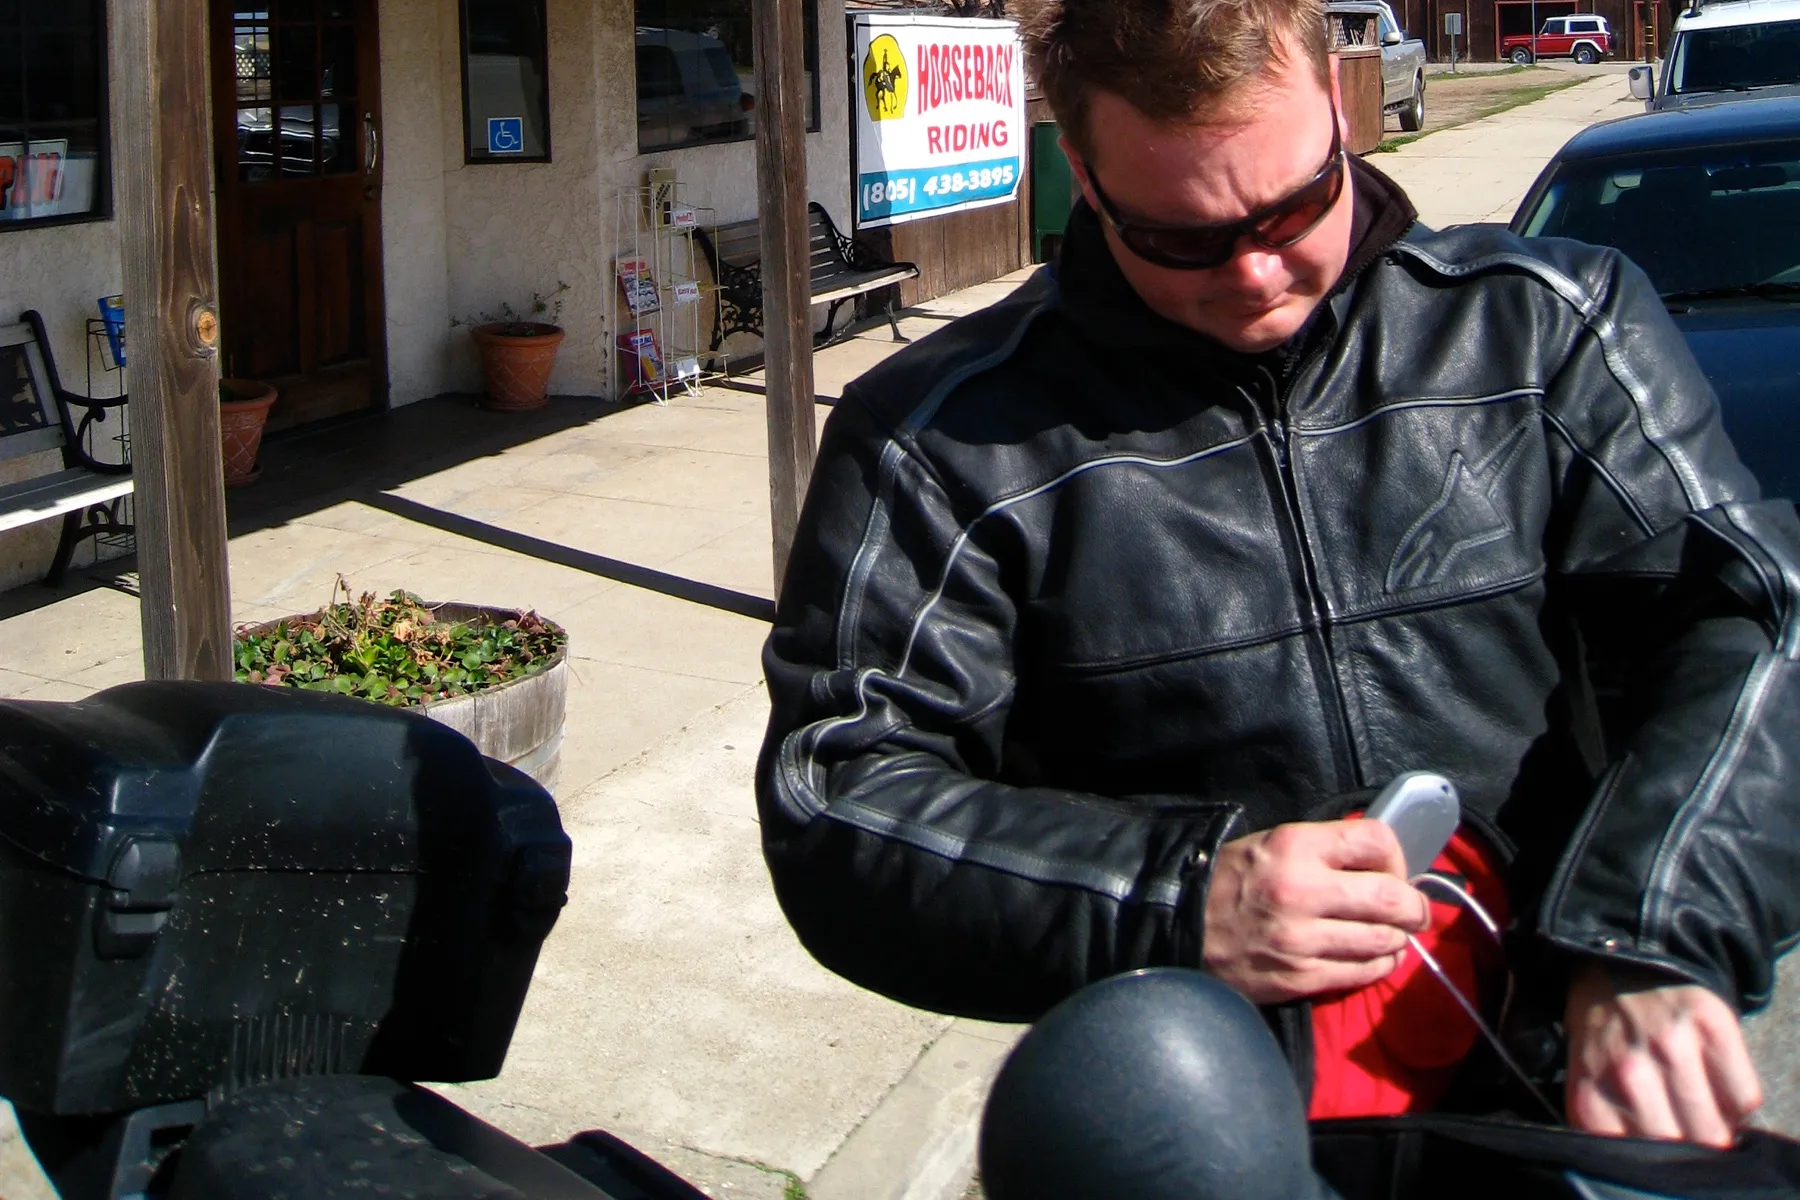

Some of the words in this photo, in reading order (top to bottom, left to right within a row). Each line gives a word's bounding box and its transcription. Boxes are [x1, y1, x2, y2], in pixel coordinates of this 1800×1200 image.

[917, 43, 1013, 115] HORSEBACK
[927, 120, 1008, 154] RIDING
[863, 177, 917, 211] (805)
[923, 165, 1014, 196] 438-3895
